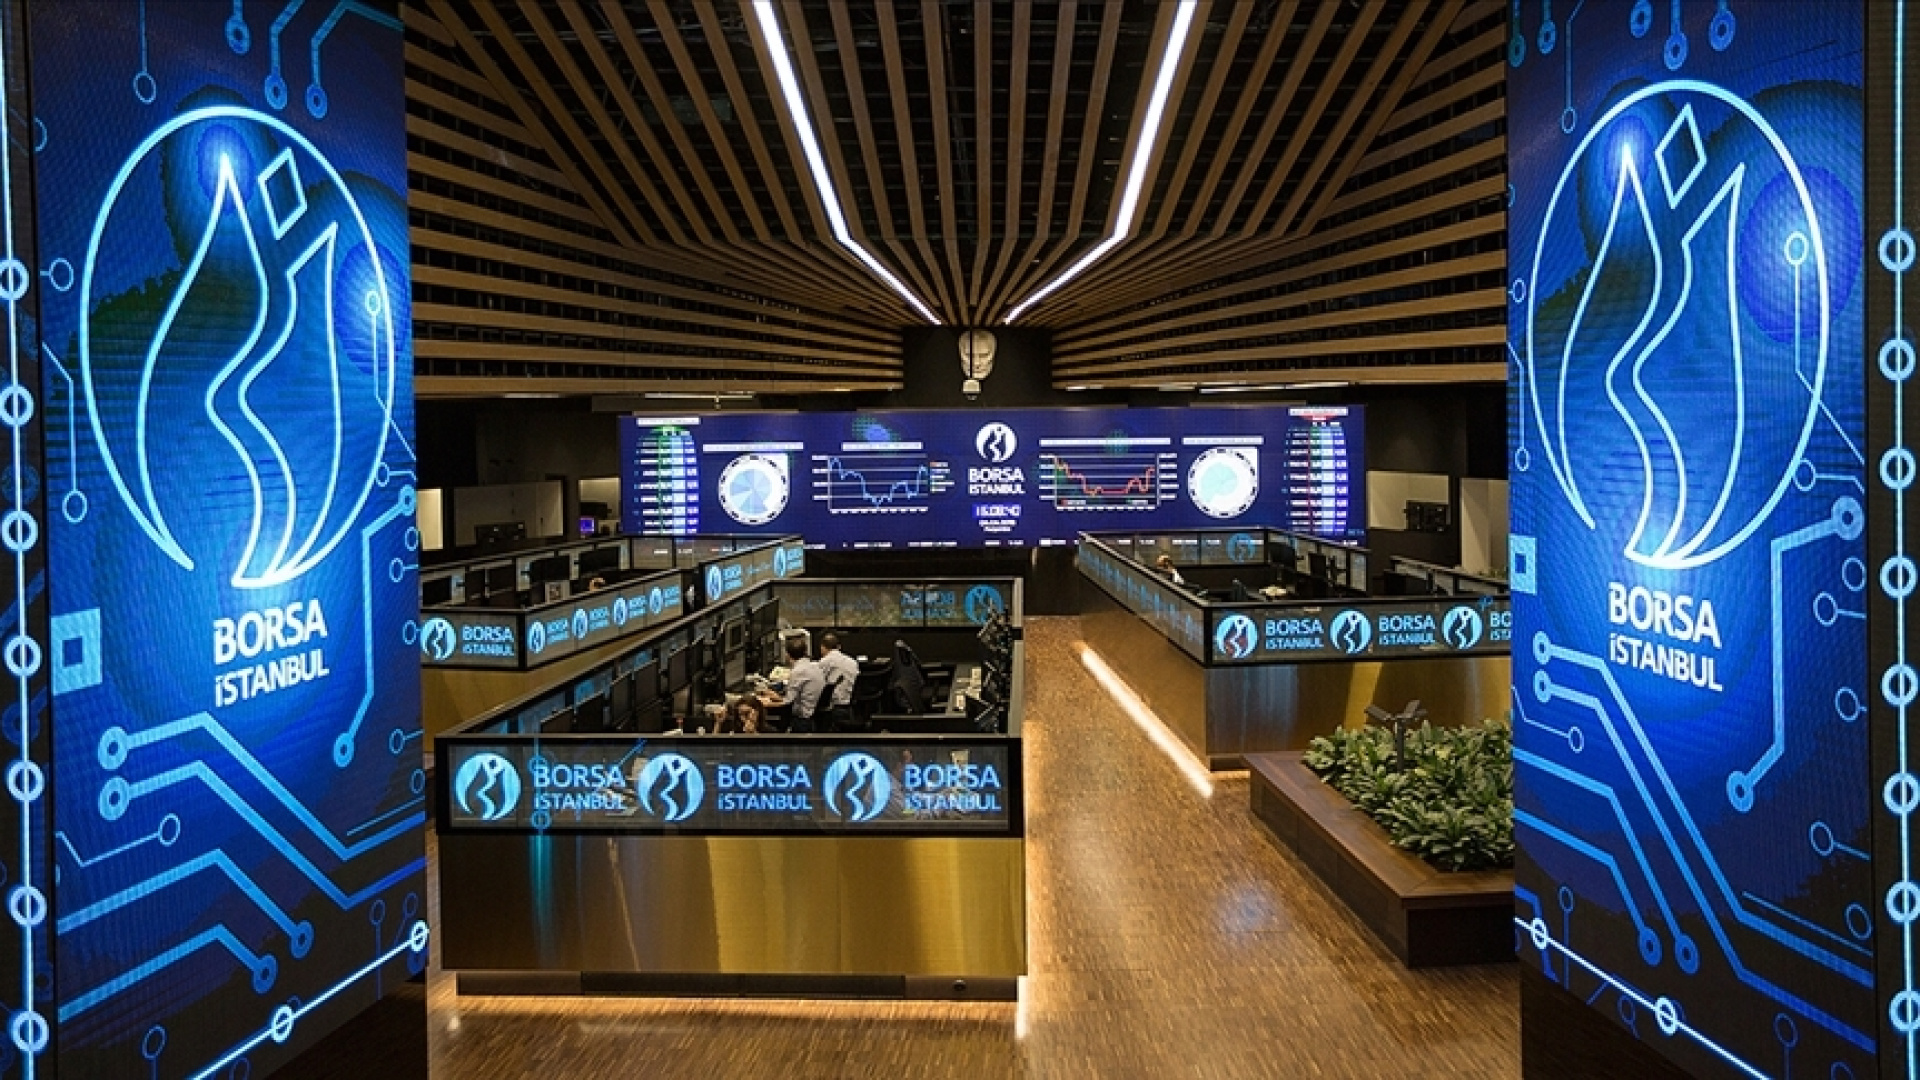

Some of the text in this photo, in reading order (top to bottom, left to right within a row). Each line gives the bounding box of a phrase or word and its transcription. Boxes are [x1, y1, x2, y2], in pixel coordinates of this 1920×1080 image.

[1265, 619, 1324, 636] BORSA
[1379, 613, 1436, 631] BORSA
[1608, 581, 1722, 650] BORSA
[213, 597, 328, 665] BORSA
[462, 625, 515, 642] BORSA
[532, 764, 626, 788] BORSA
[718, 764, 812, 788] BORSA
[905, 764, 1001, 788] BORSA
